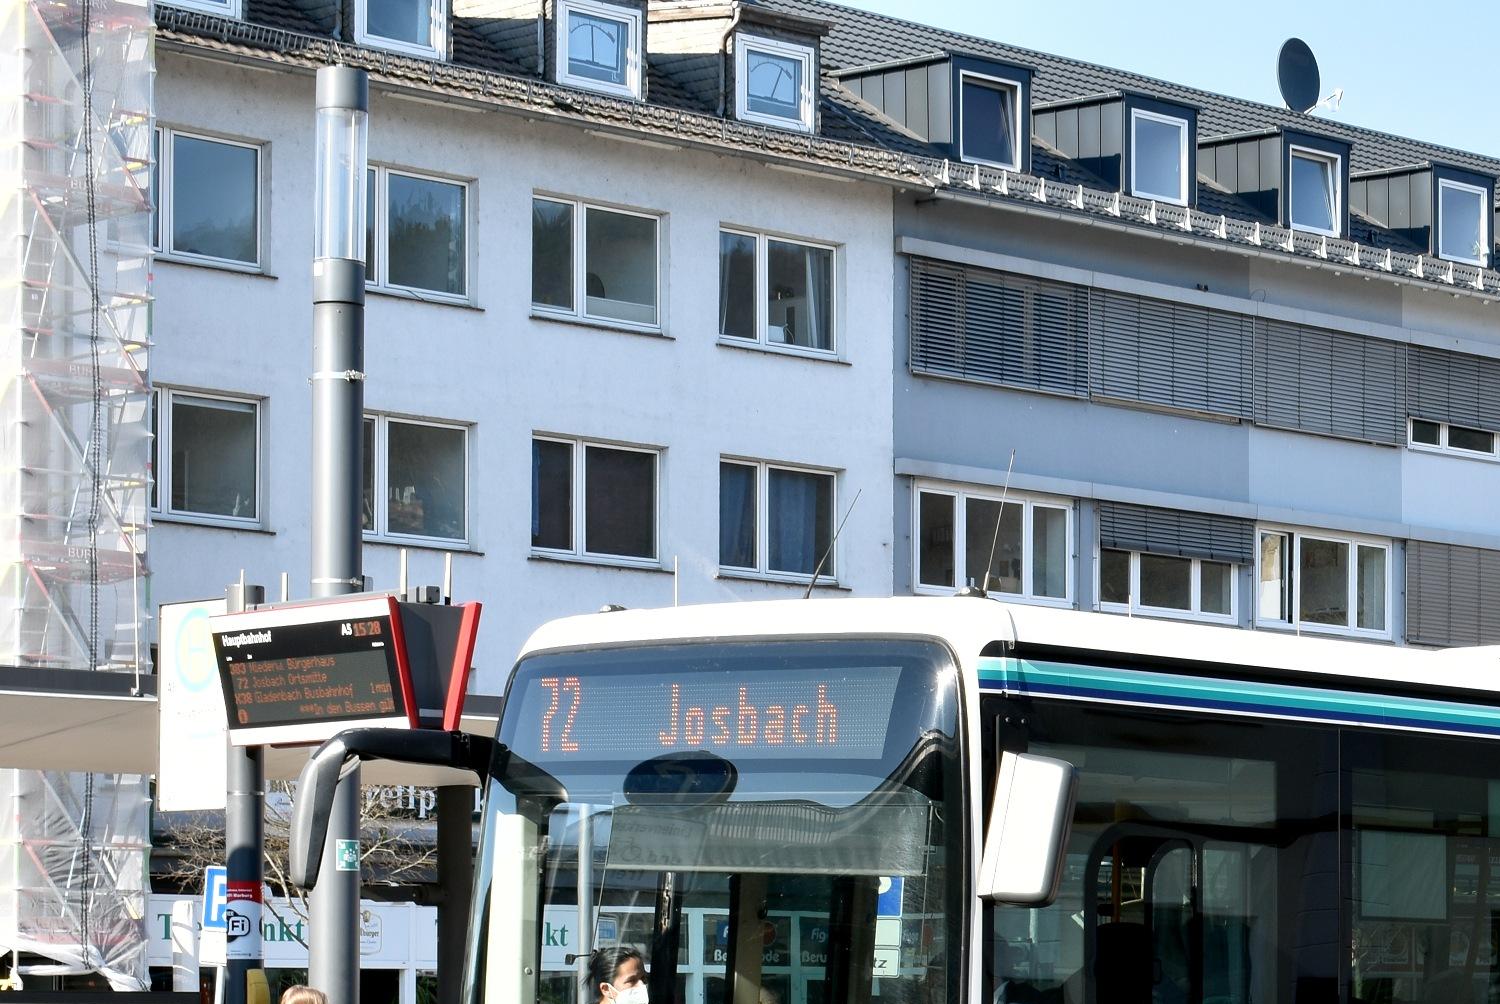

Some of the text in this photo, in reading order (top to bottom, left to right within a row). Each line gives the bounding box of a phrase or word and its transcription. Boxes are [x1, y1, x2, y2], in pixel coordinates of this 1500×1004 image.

[222, 629, 272, 648] Hauptbahnhof
[252, 675, 287, 689] Josbach
[541, 677, 838, 752] 72 Josbach
